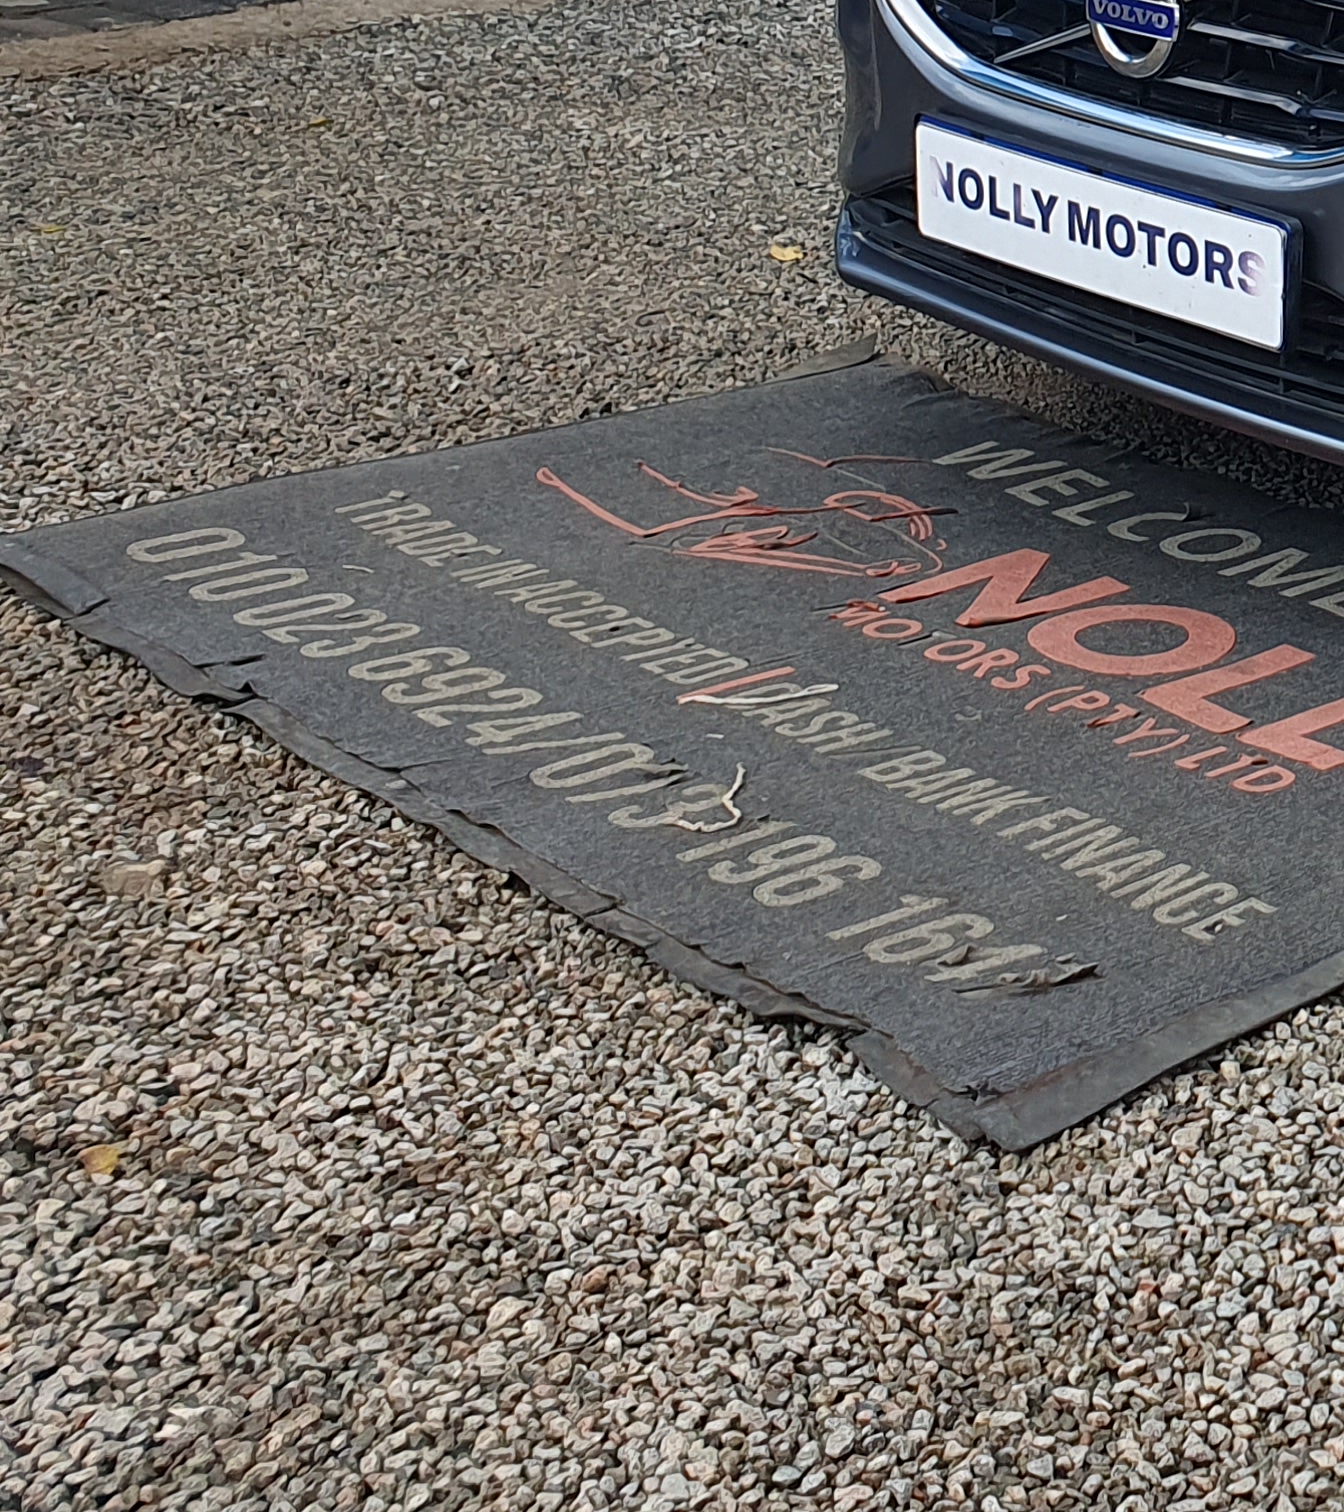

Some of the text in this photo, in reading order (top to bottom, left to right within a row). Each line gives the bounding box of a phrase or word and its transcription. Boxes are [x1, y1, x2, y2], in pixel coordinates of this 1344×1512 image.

[930, 155, 1266, 297] NOLLY MOTORS
[126, 527, 309, 602] 010
[233, 592, 421, 659] 023
[676, 820, 882, 907] 196
[334, 490, 503, 567] TRADE
[998, 807, 1279, 943] FINANCE
